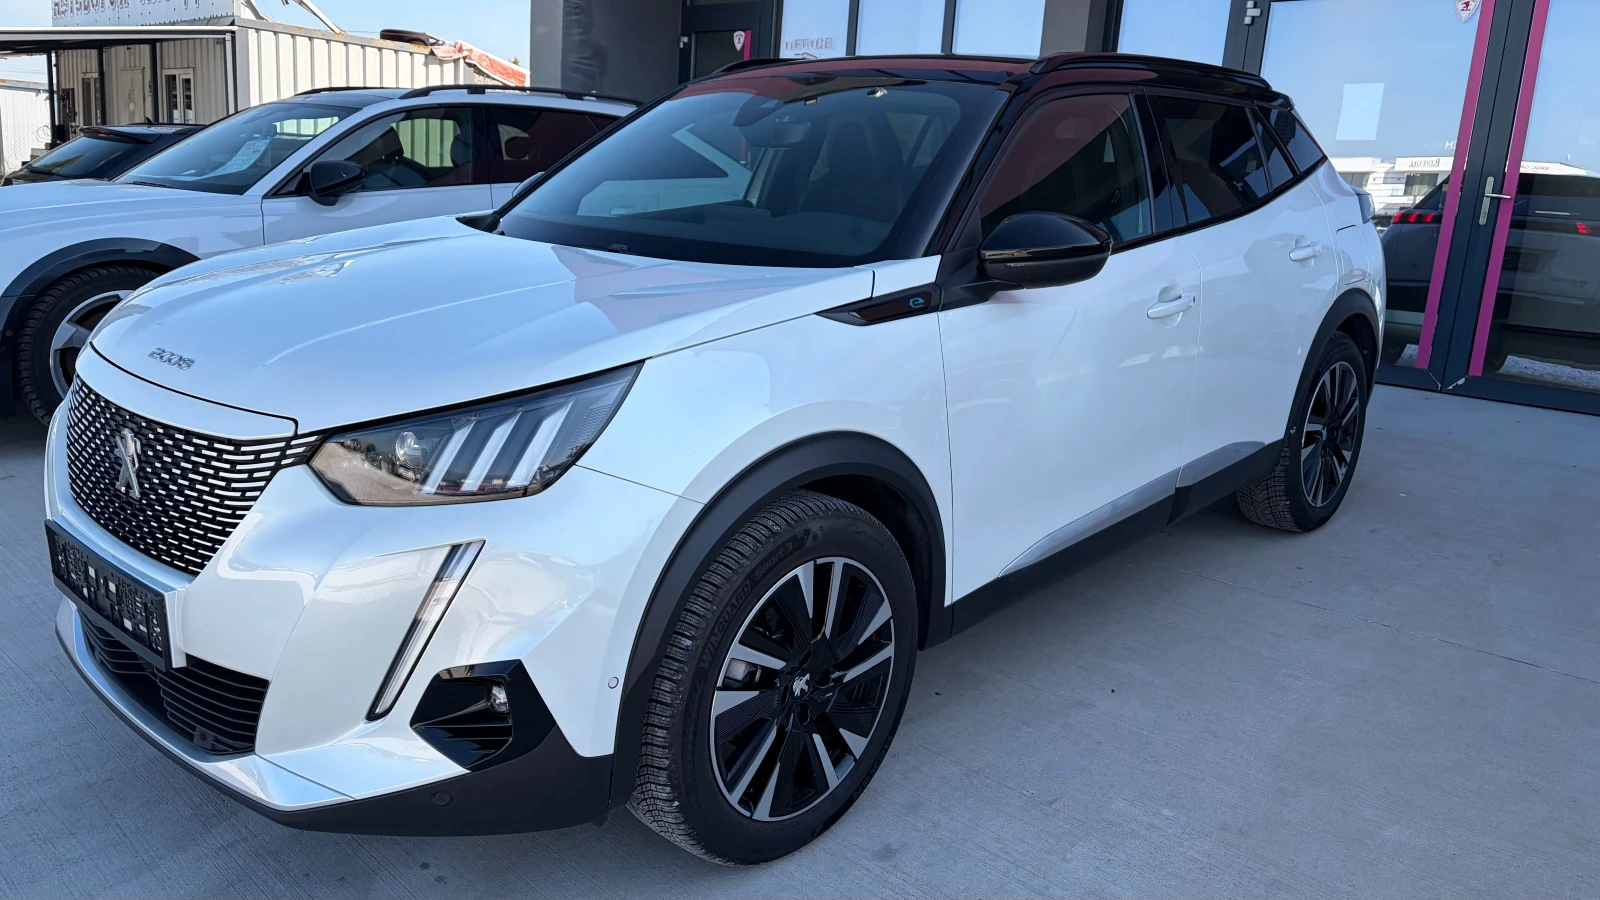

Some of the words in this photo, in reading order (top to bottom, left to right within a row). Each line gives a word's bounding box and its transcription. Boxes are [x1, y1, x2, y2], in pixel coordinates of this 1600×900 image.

[908, 297, 925, 309] e
[147, 347, 196, 371] 2008
[699, 577, 752, 670] WINGUARD
[754, 548, 785, 580] Sport
